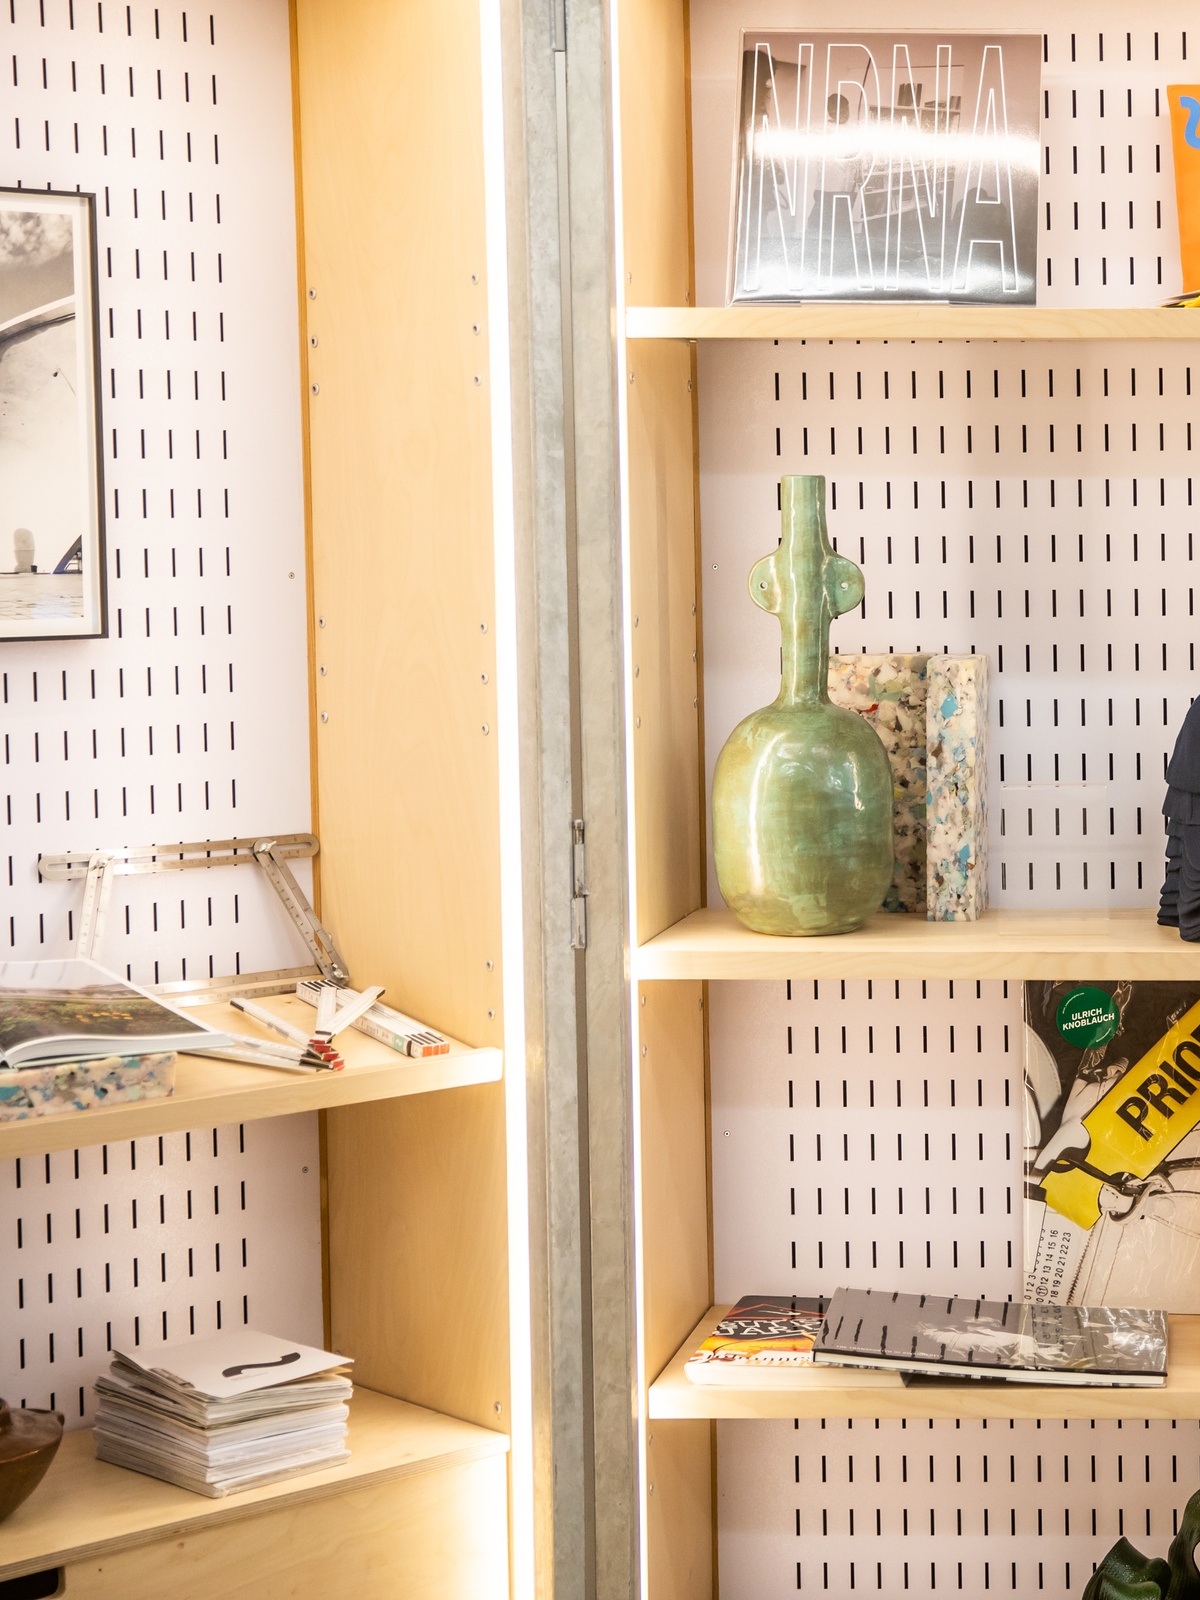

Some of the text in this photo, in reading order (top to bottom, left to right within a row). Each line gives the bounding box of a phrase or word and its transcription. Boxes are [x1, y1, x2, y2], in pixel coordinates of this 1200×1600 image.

[744, 43, 1019, 293] NRNA
[1071, 1007, 1103, 1021] ULRICH
[1062, 1012, 1115, 1031] KNOBLAUCH
[1050, 1229, 1058, 1238] 16
[1062, 1231, 1072, 1243] 23
[1048, 1241, 1056, 1250] 15
[1060, 1244, 1069, 1255] 22
[1045, 1253, 1053, 1262] 14
[1057, 1256, 1066, 1266] 21
[1043, 1265, 1051, 1274] 13
[1054, 1267, 1064, 1278] 20
[1040, 1276, 1049, 1285] 12
[1052, 1279, 1061, 1288] 19
[1050, 1289, 1059, 1298] 18
